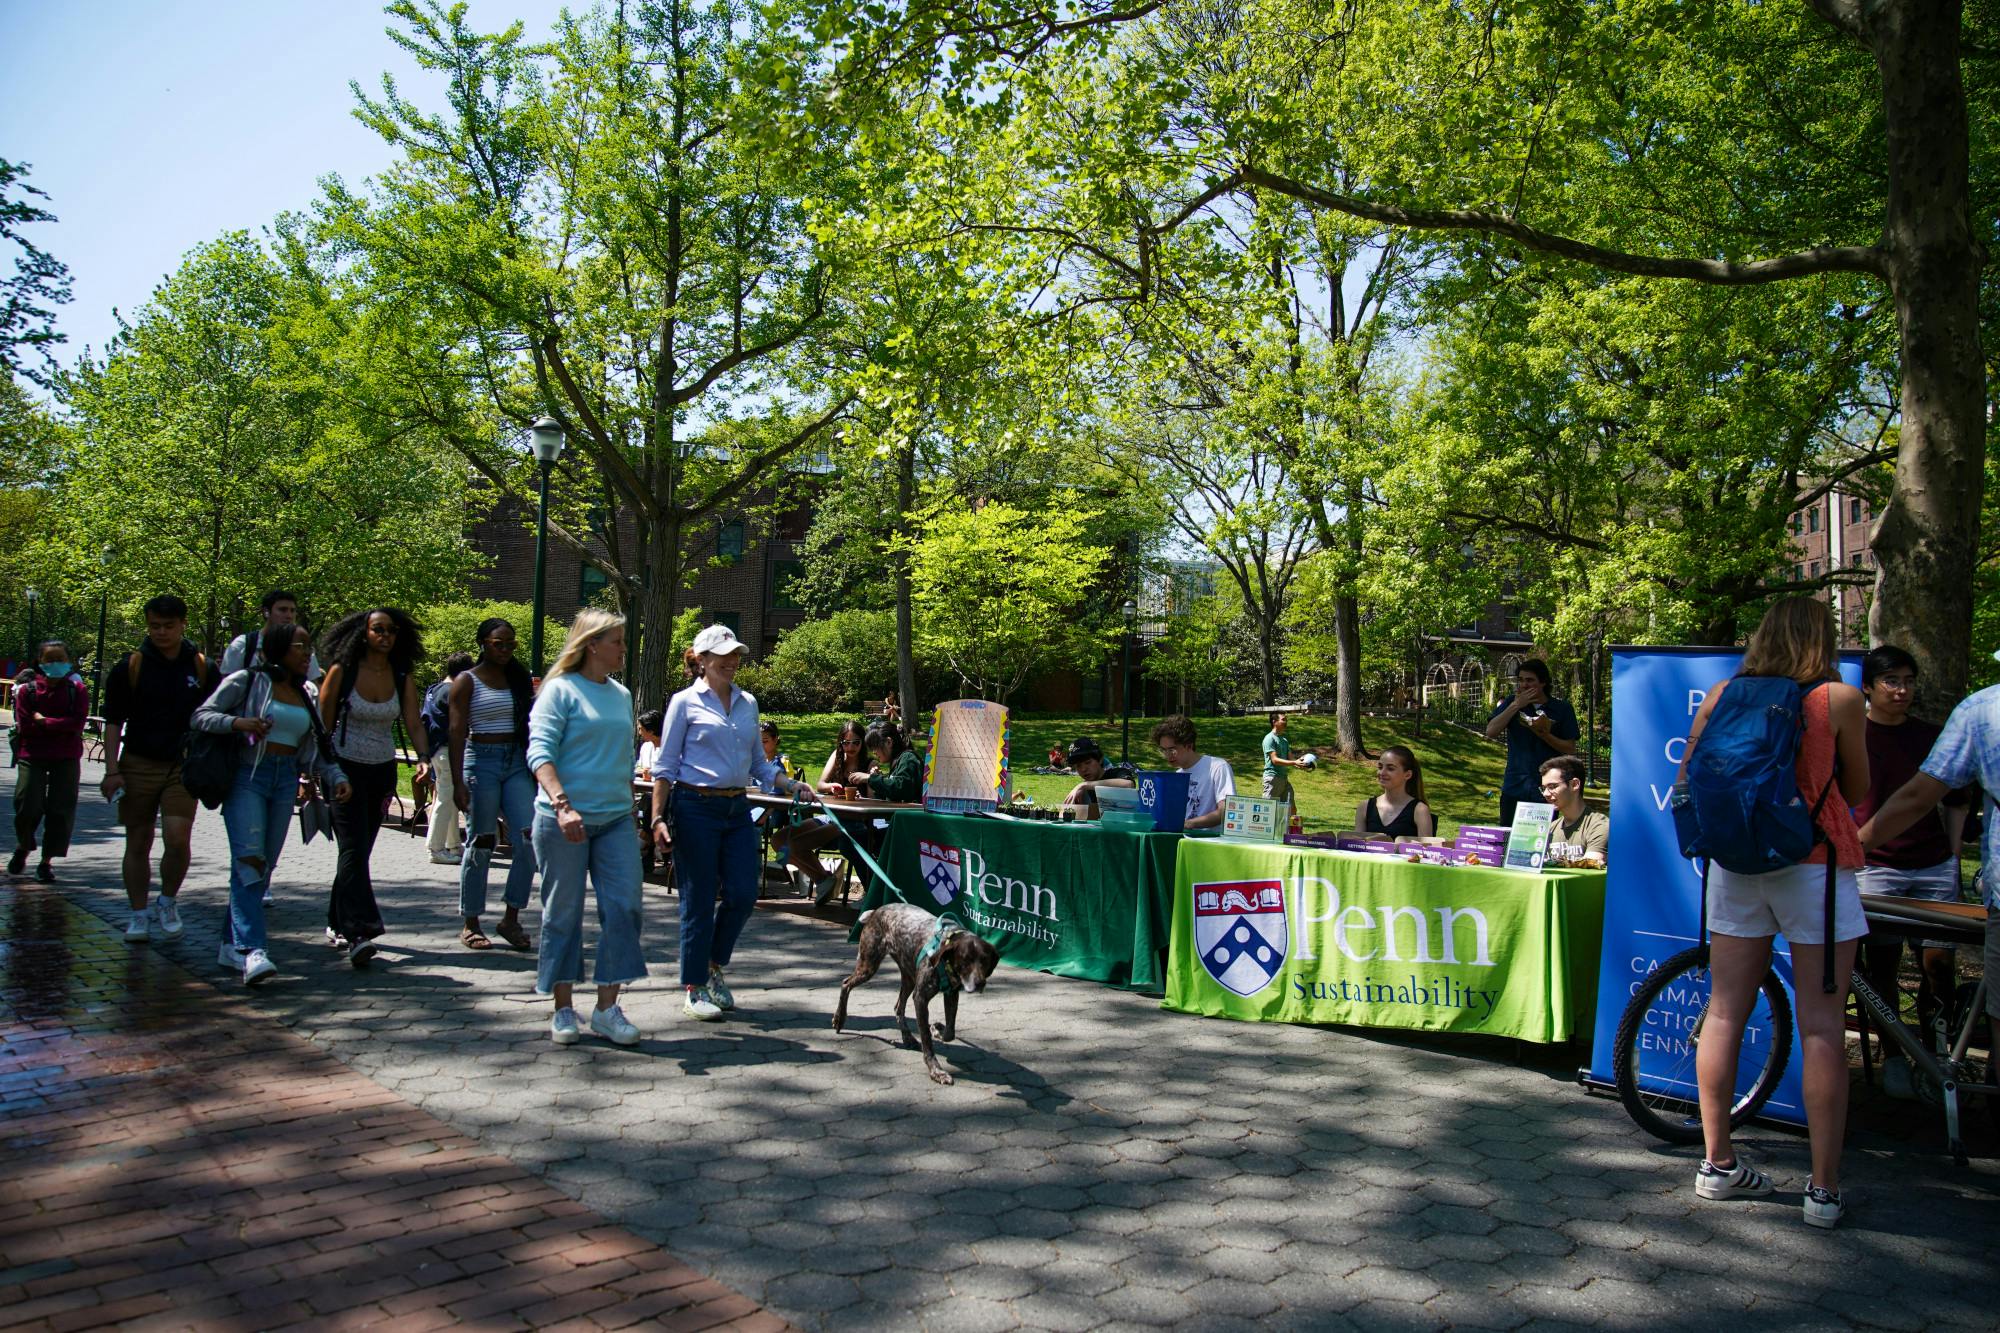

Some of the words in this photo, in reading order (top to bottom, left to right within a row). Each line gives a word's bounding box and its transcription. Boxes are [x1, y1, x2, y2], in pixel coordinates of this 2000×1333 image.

[962, 848, 1059, 921] Penn
[1290, 877, 1497, 966] Penn
[1293, 973, 1500, 1022] Sustainability
[1644, 1008, 1698, 1033] CTIO
[1850, 969, 1897, 1024] ondale
[1635, 1032, 1690, 1057] ENN
